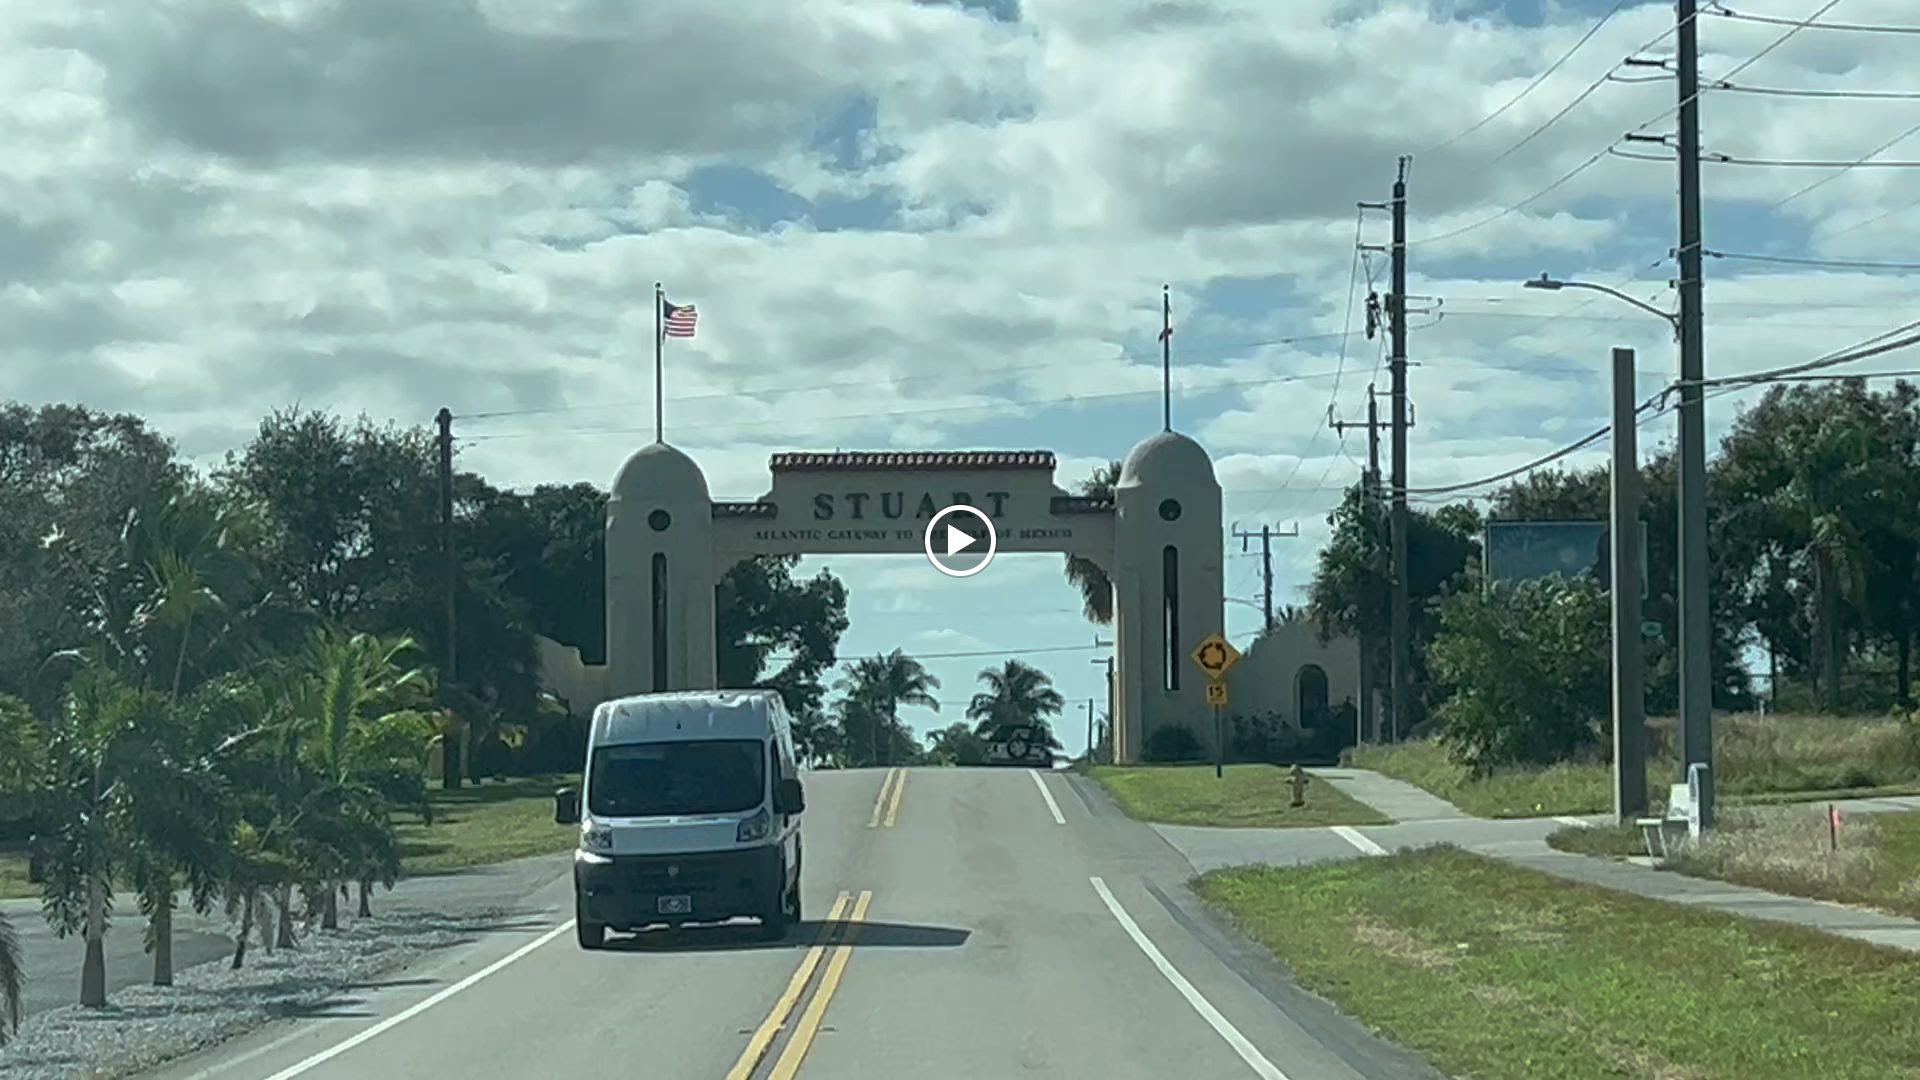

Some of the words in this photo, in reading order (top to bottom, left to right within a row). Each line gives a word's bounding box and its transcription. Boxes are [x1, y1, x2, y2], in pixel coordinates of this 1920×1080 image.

[814, 491, 1010, 520] STUART
[754, 530, 823, 540] ATLANTIC
[827, 529, 888, 540] GATEWAY
[896, 530, 913, 540] TO
[1020, 529, 1073, 540] MEXICO
[1209, 686, 1224, 697] 15
